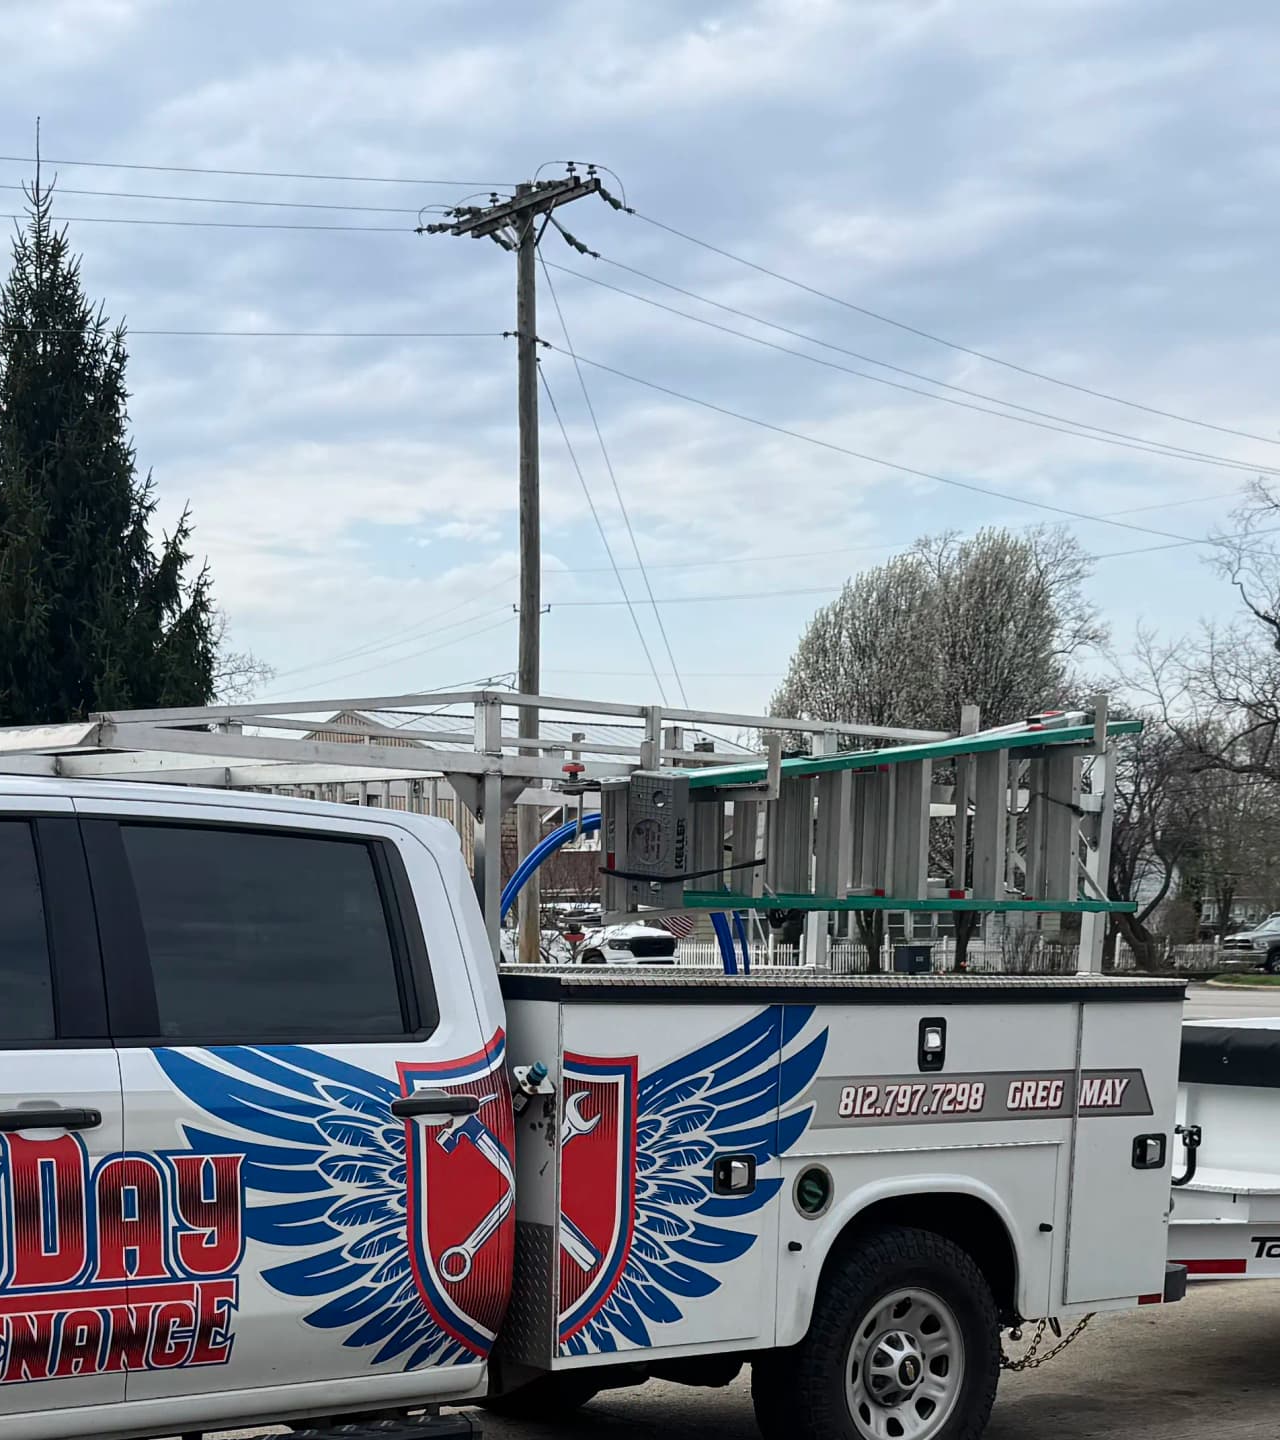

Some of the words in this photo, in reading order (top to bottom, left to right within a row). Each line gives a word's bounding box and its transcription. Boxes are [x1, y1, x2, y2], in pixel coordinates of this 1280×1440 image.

[674, 818, 686, 870] KELLER
[838, 1082, 985, 1117] 812.797.7298
[1006, 1080, 1064, 1111] GREG
[1078, 1078, 1130, 1108] MAY
